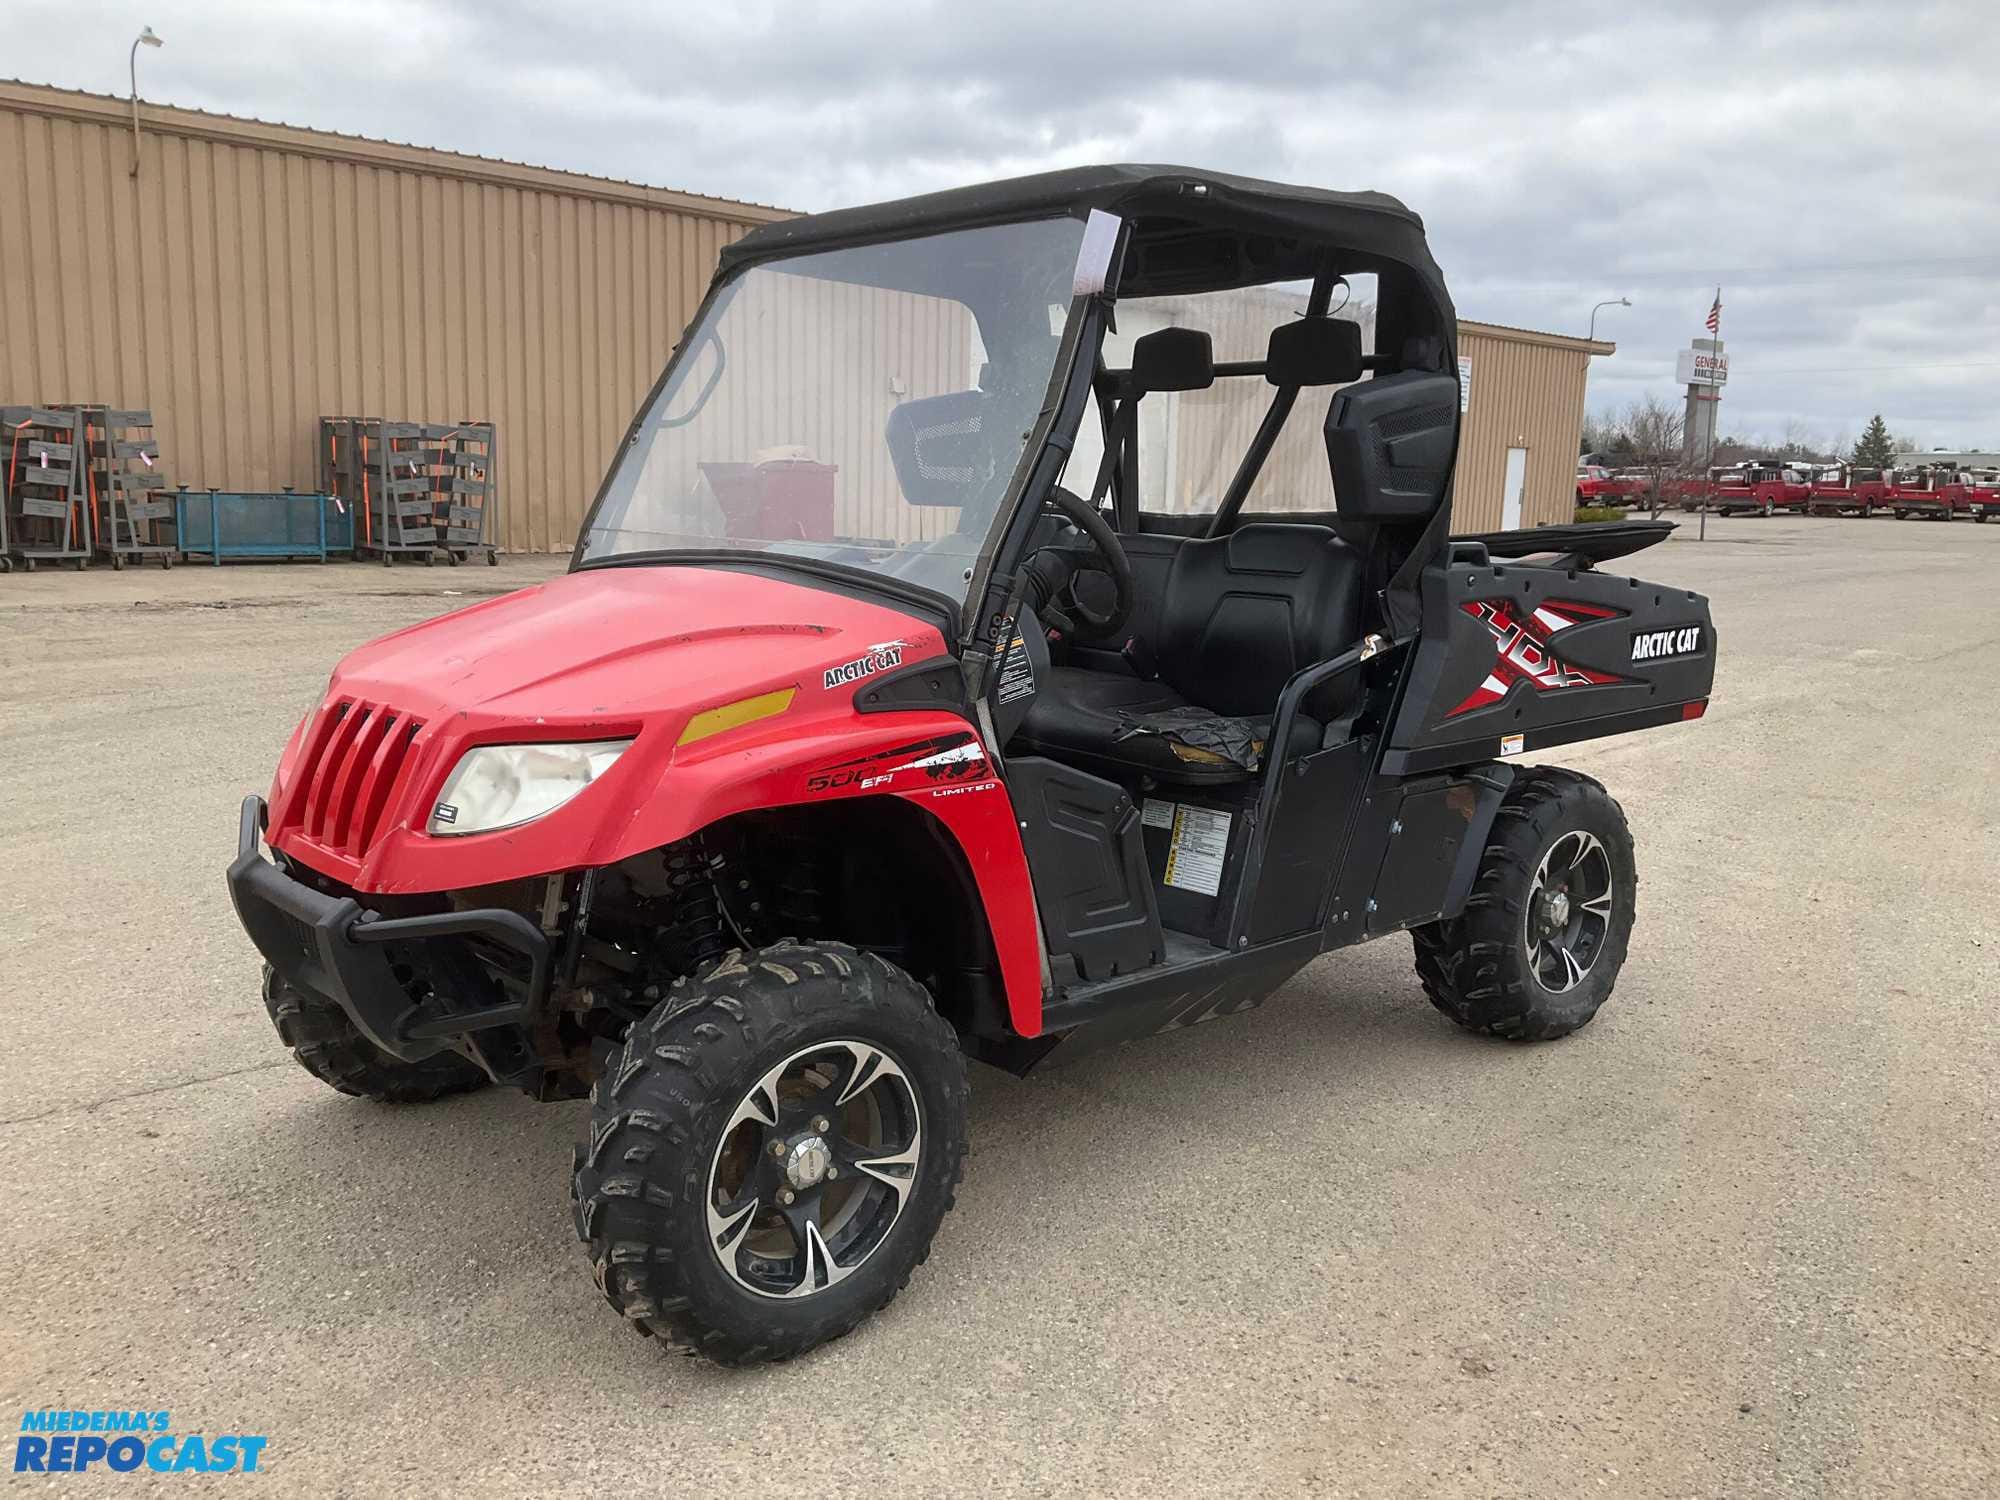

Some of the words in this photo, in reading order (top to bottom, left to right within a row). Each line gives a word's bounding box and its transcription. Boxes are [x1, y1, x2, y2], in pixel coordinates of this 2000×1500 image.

[1632, 630, 1676, 660] ARCTIC
[1676, 627, 1700, 653] CAT
[825, 656, 875, 689] ARCTIC
[875, 647, 901, 670] CAT
[860, 773, 894, 789] EFI
[933, 783, 995, 797] LIMITED
